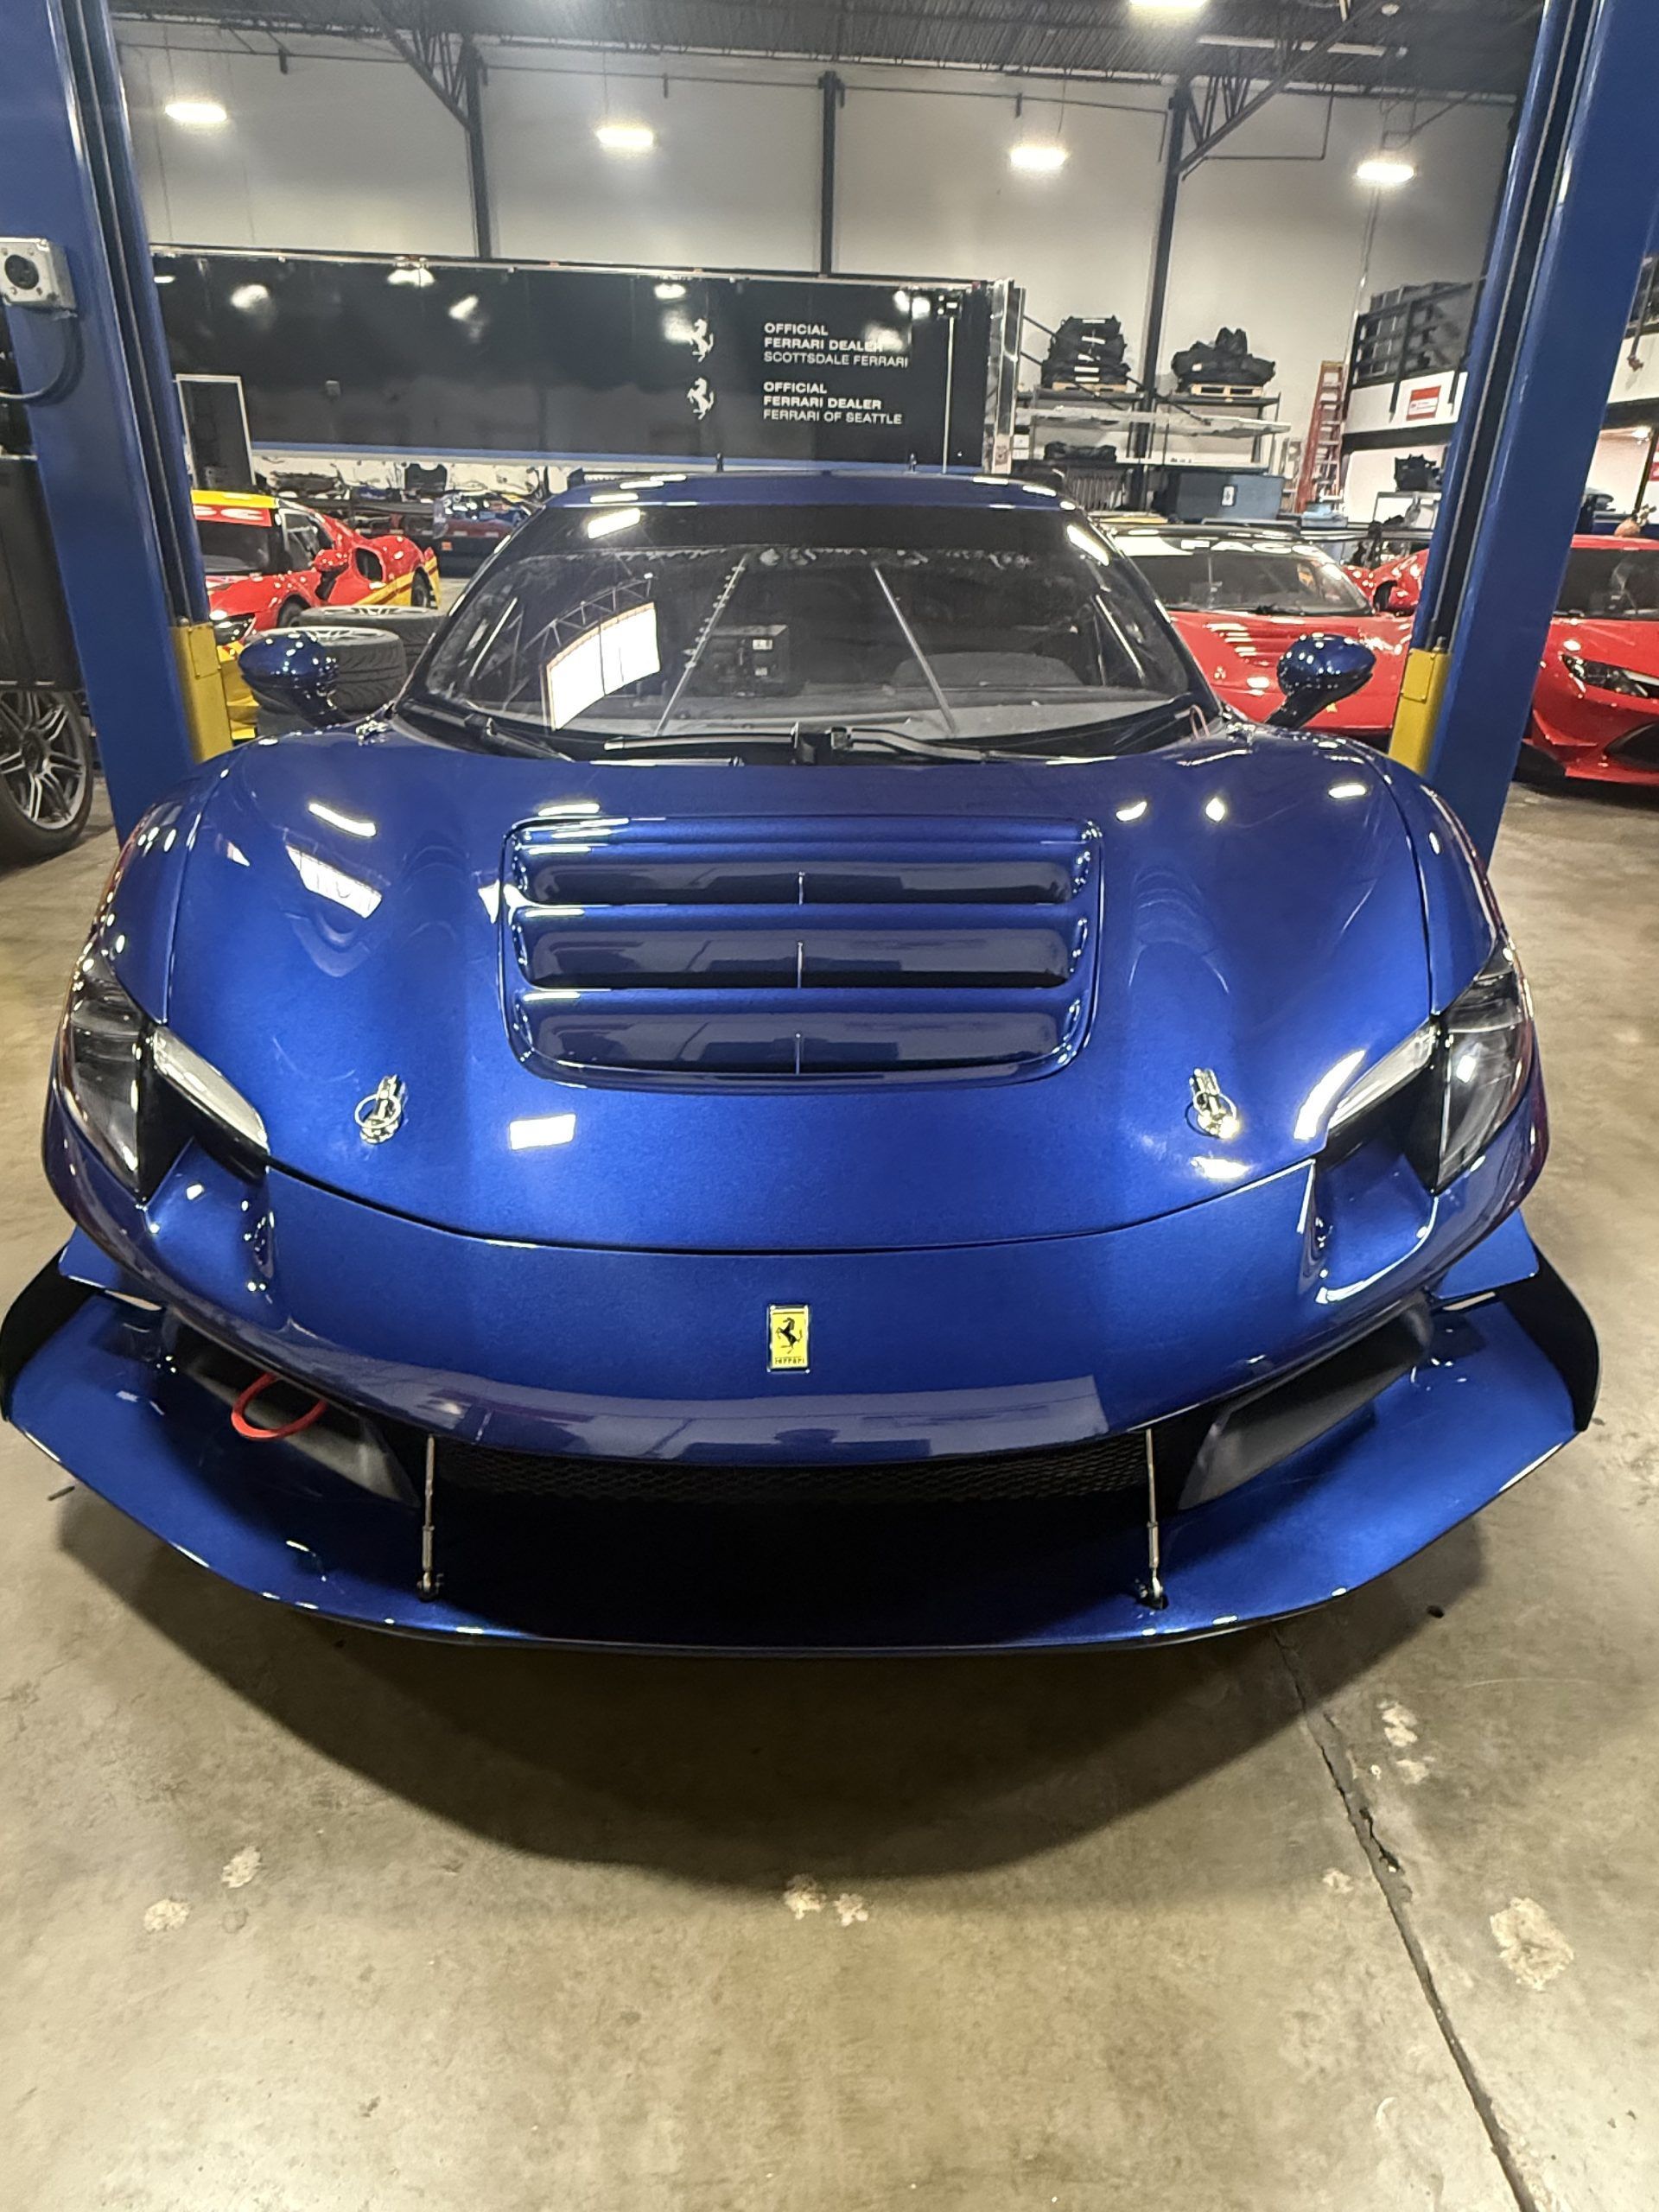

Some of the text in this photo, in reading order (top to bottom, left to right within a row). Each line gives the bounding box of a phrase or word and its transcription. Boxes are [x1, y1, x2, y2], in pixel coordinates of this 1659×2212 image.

[764, 322, 829, 336] OFFICIAL
[764, 337, 824, 350] FERRARI
[764, 351, 908, 368] SCOTTSDALE FERRARI
[763, 381, 827, 394] OFFICIAL
[764, 395, 881, 410] FERRARI DEALER
[763, 409, 903, 425] FERRARI OF SEATTLE
